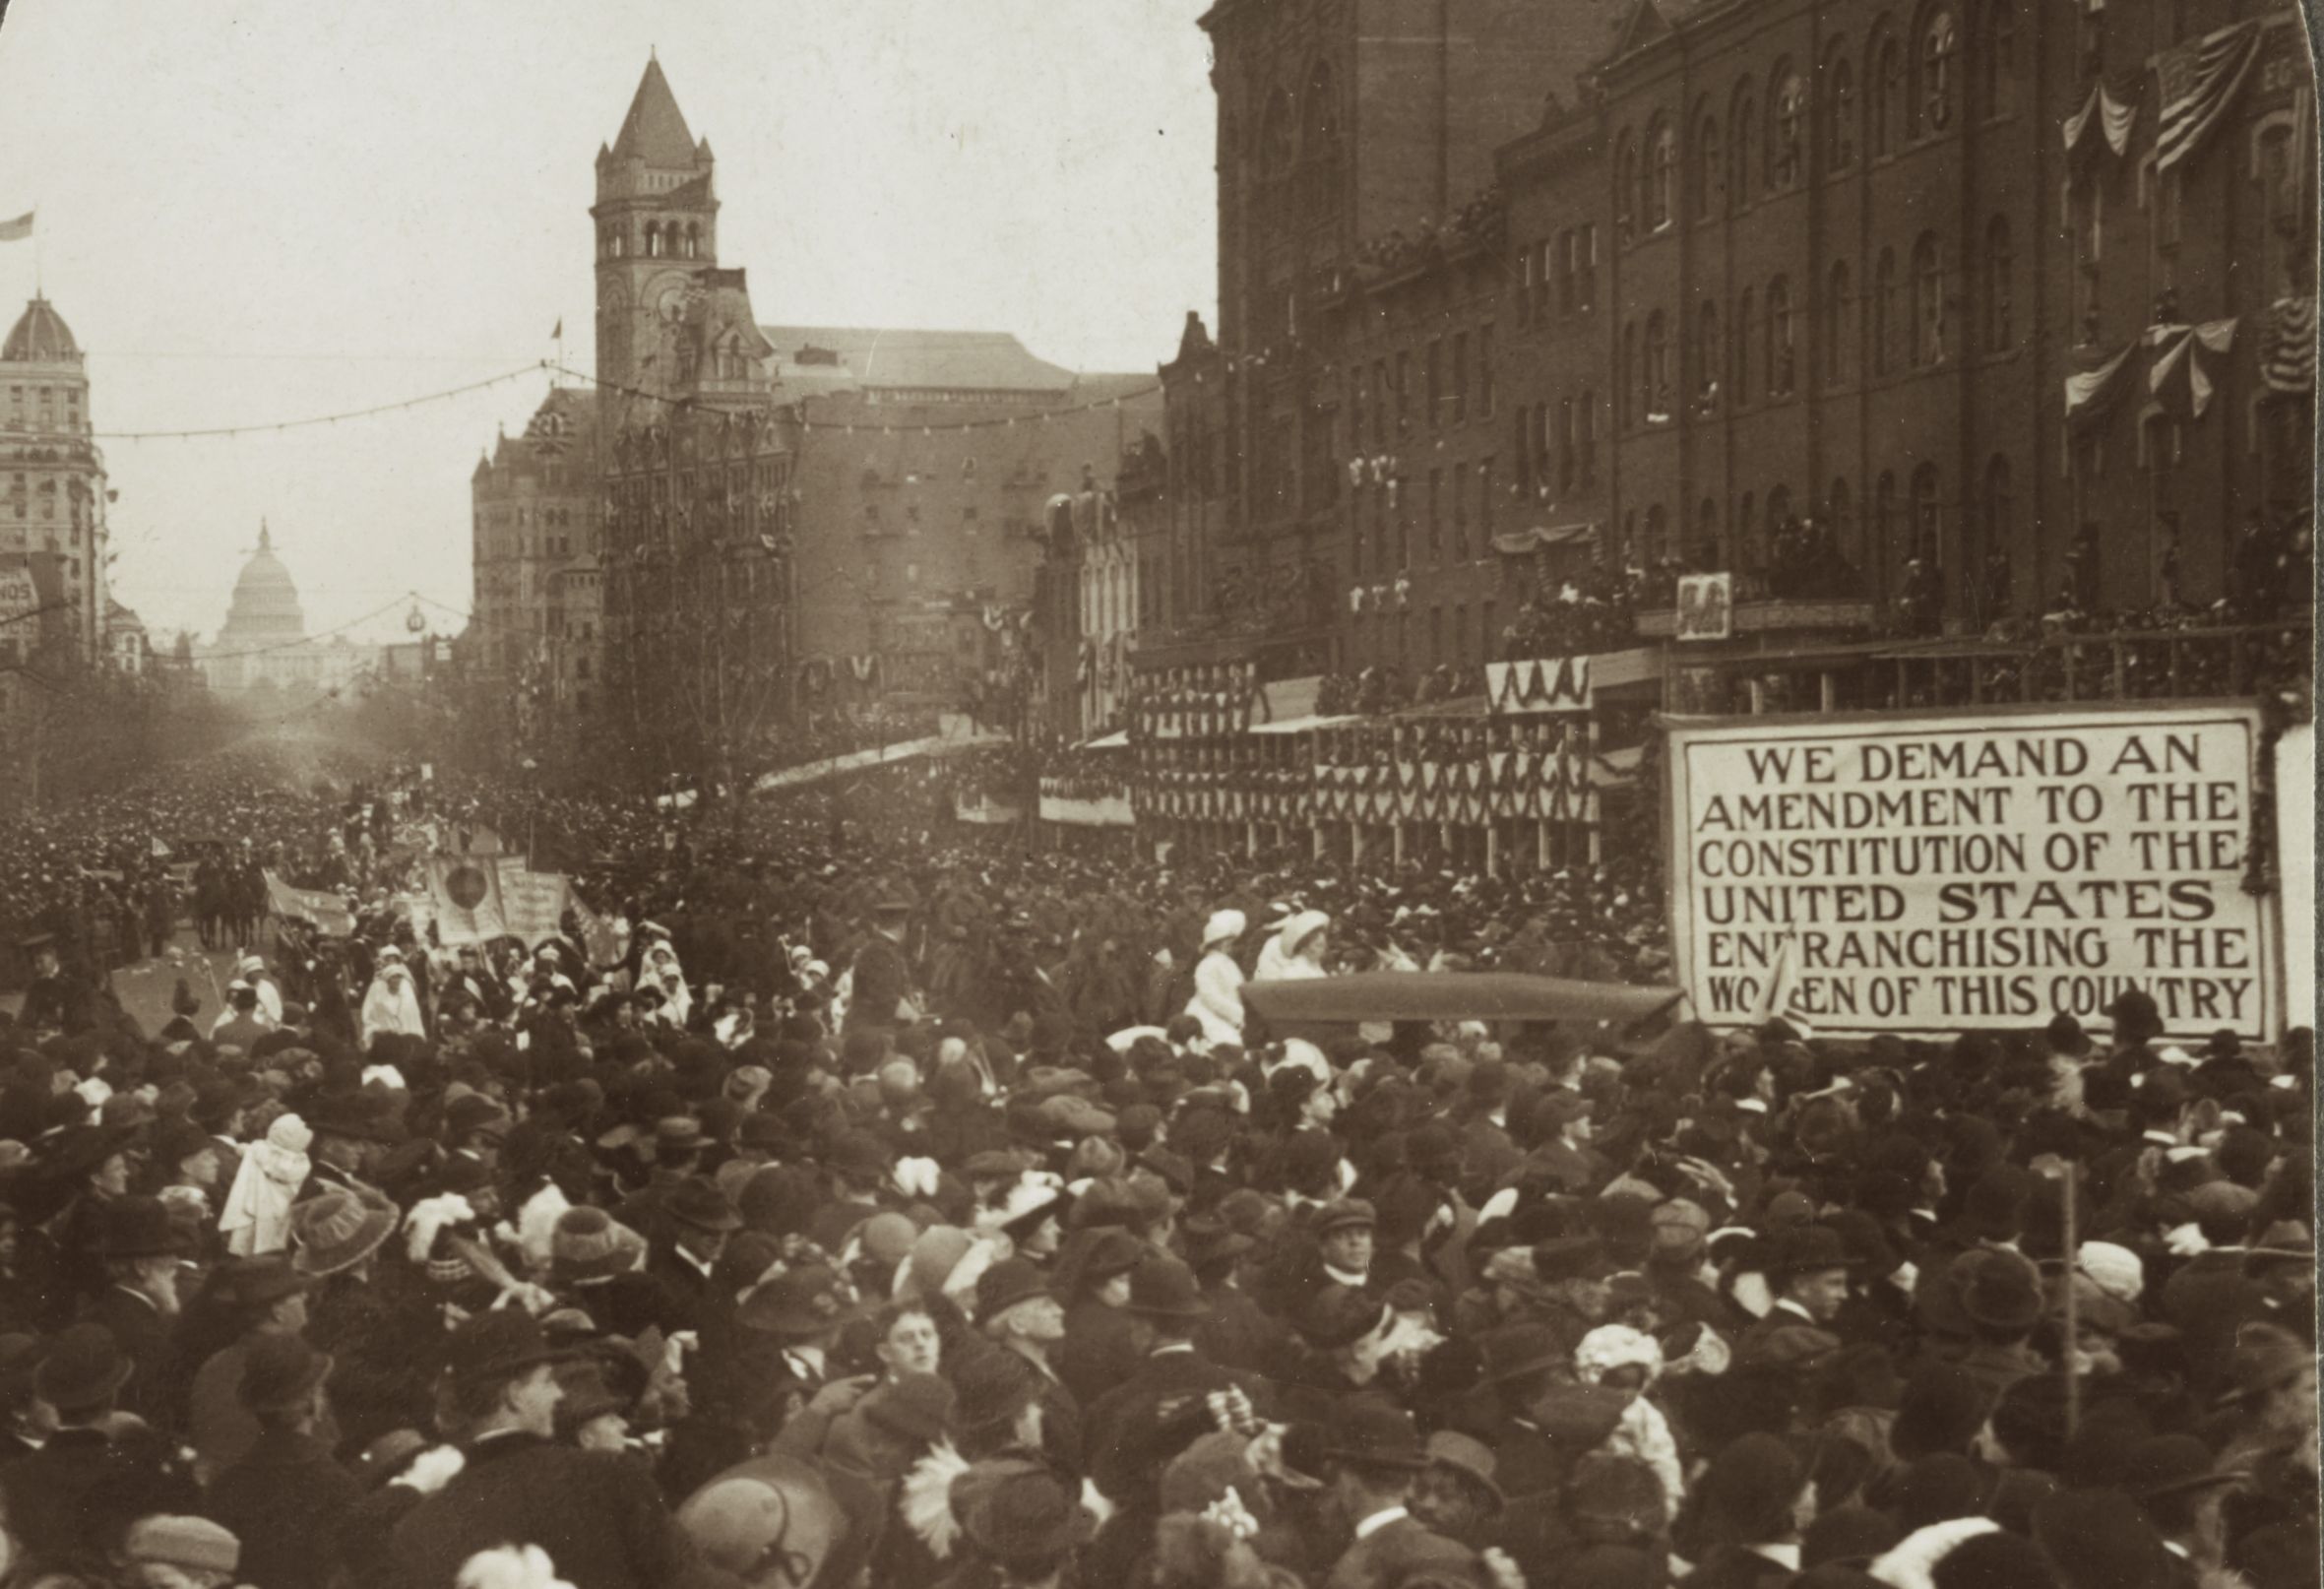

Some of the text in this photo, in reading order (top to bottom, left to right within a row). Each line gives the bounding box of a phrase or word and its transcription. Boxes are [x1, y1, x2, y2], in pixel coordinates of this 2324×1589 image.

[1746, 732, 2201, 784] WE DEMAND AN
[1696, 781, 2240, 833] AMENDMENT TO THE
[1698, 829, 2240, 877] CONSTITUTION OF THE
[1703, 878, 2216, 925] UNITED STATES
[2134, 927, 2250, 970] THE
[1708, 975, 1858, 1015] WOEN
[1868, 975, 1920, 1018] OF
[1931, 974, 2039, 1018] THIS
